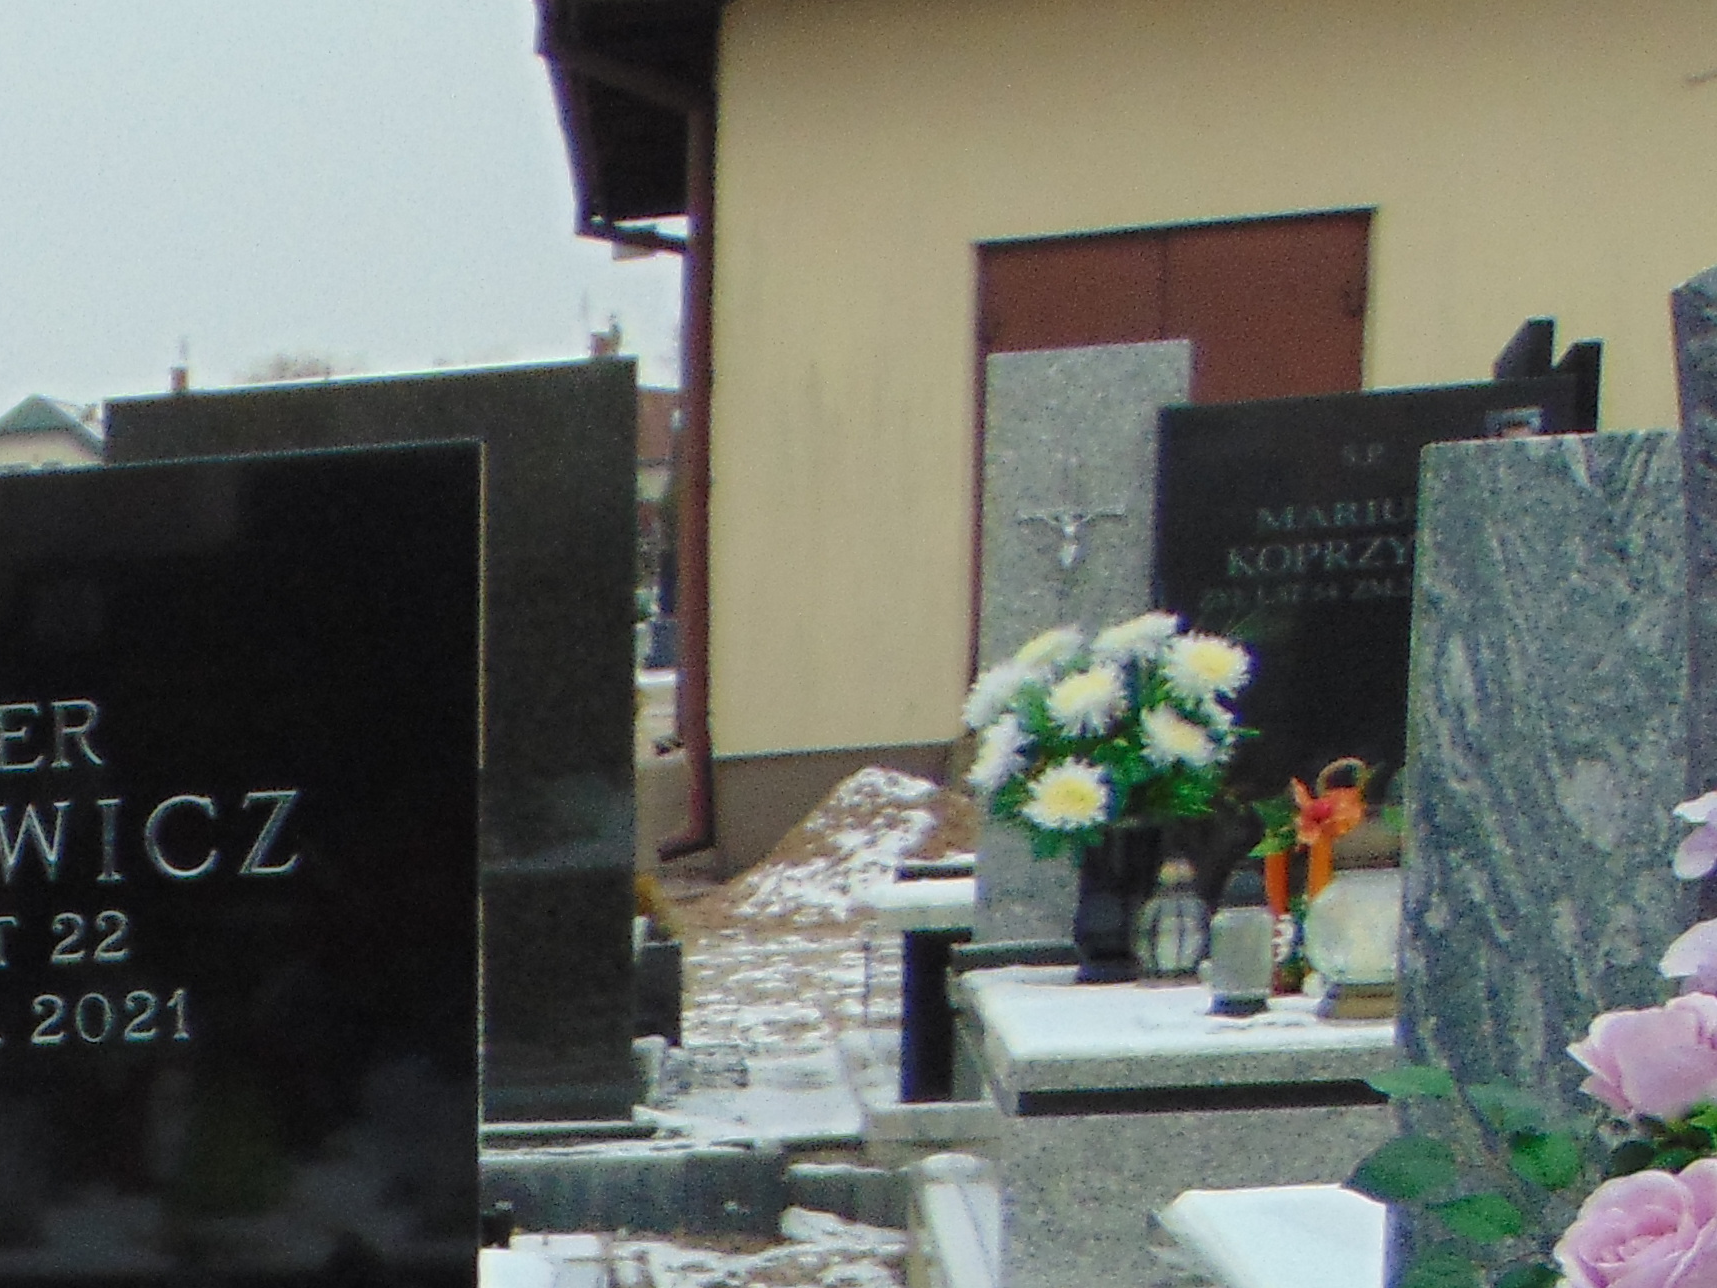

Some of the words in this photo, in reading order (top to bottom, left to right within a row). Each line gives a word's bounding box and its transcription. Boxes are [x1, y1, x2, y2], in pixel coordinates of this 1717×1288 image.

[1257, 498, 1411, 531] MARIU
[1226, 534, 1415, 578] KOPRZY
[50, 909, 131, 964] 22
